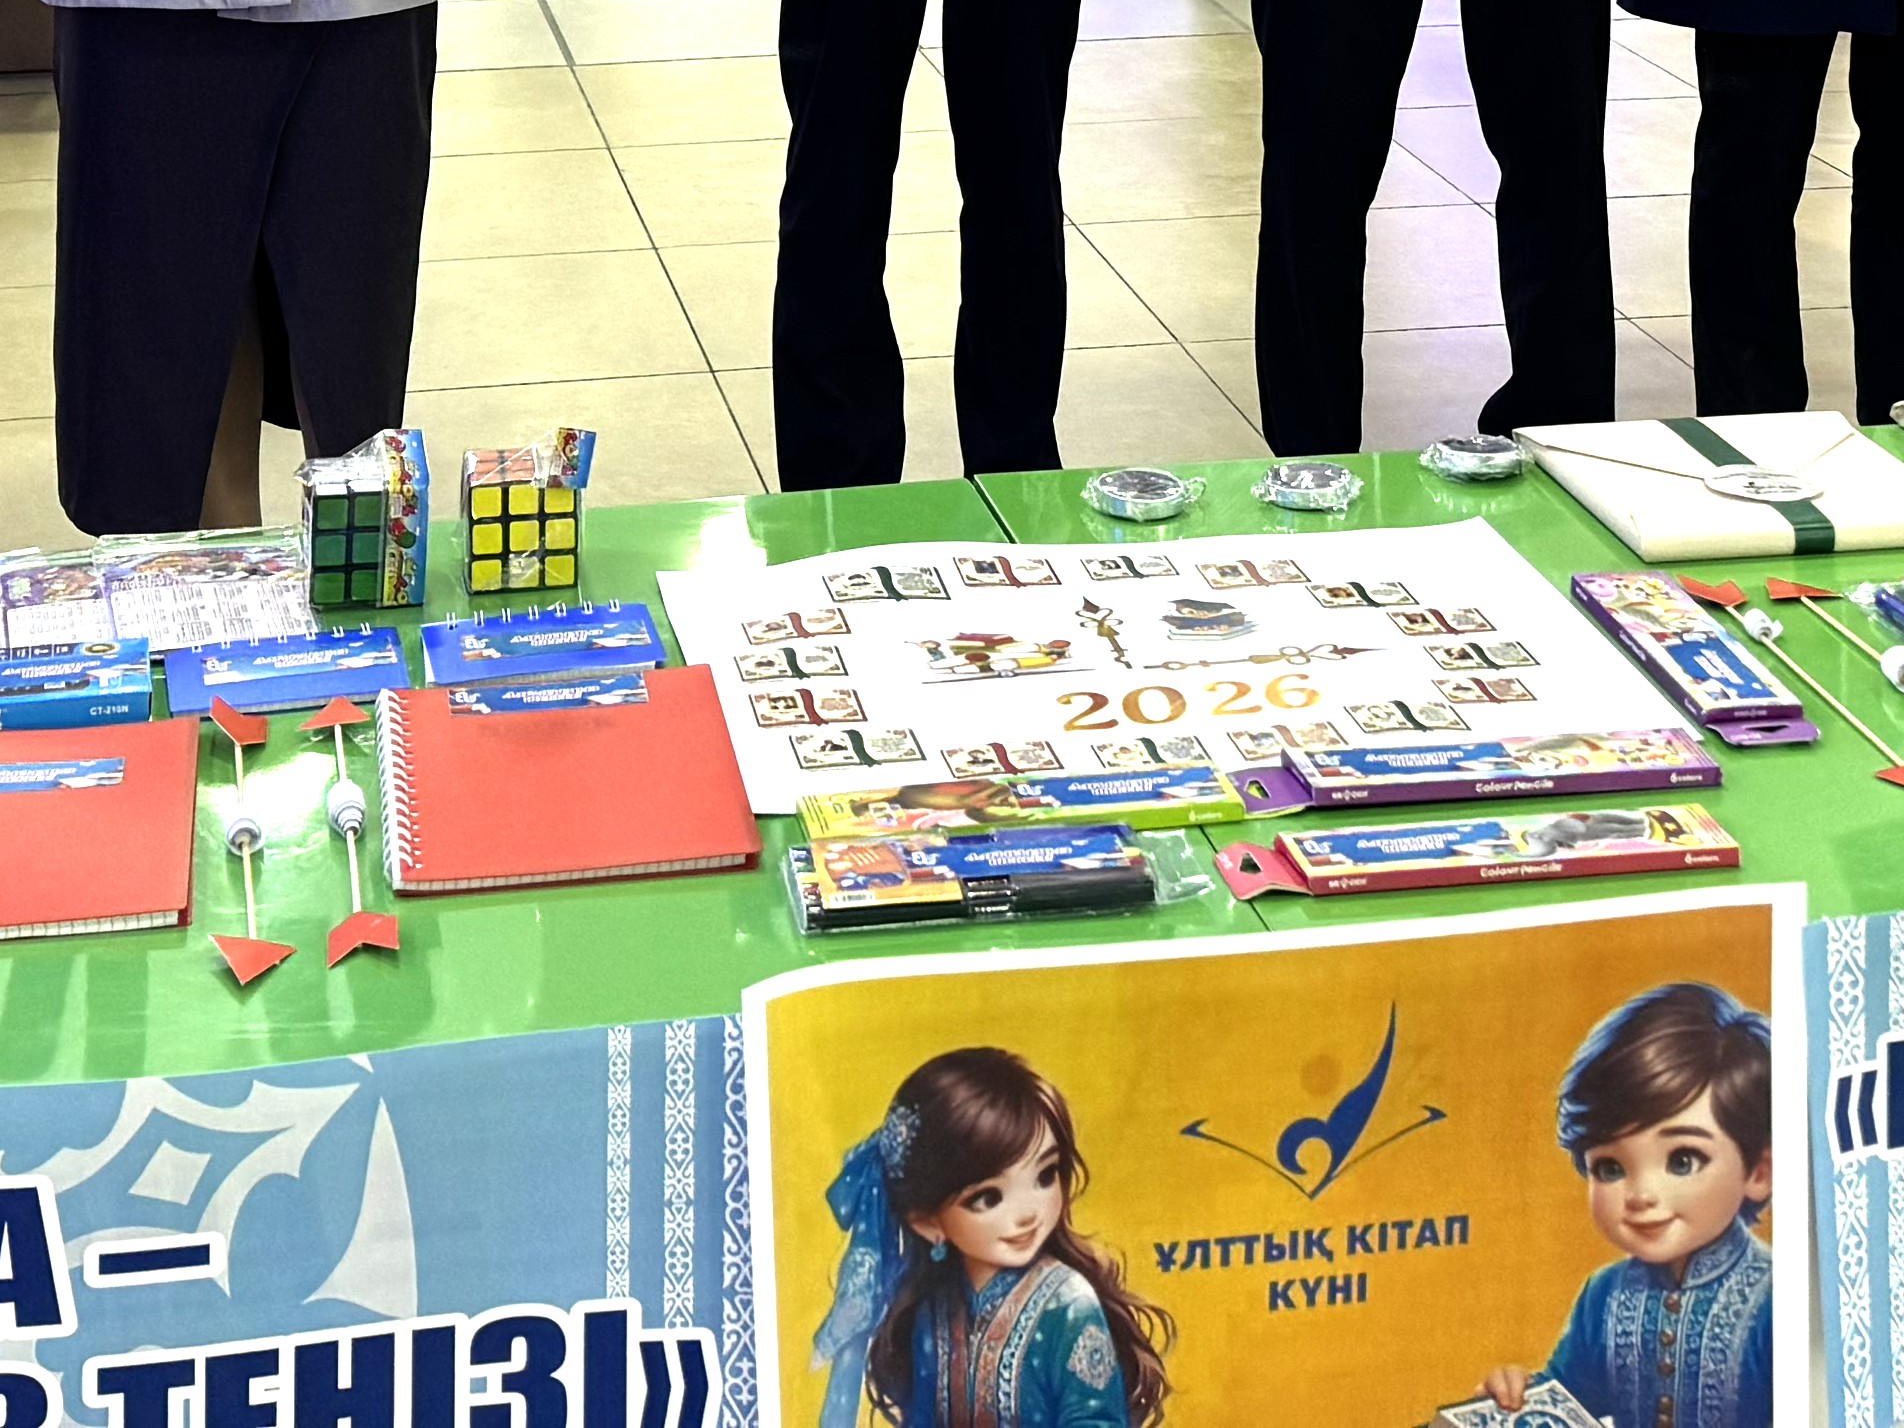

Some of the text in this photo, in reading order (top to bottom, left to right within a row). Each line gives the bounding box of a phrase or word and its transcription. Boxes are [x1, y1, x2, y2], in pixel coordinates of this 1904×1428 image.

[1056, 674, 1322, 732] 2026
[1153, 1214, 1471, 1272] ҰЛТТЫҚ КІТАП
[1268, 1273, 1368, 1311] КҮНІ
